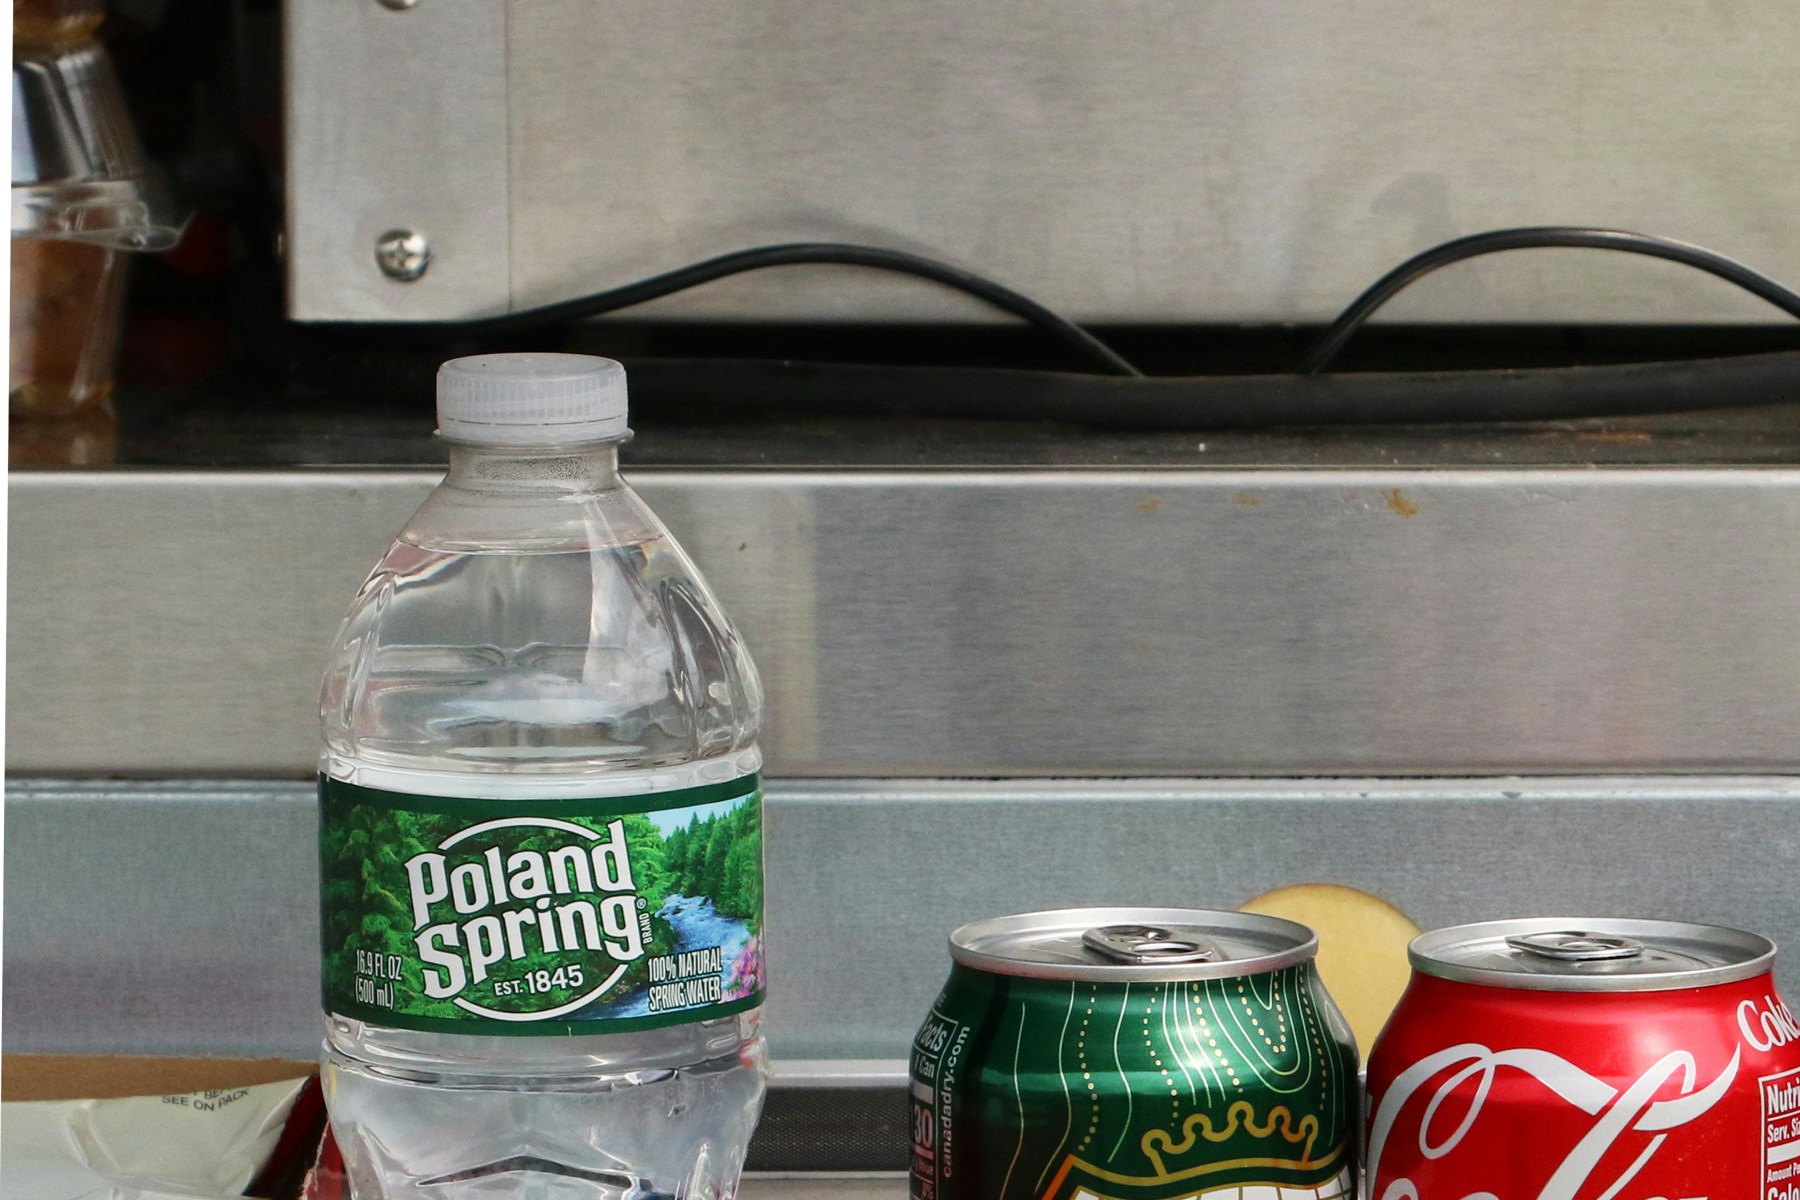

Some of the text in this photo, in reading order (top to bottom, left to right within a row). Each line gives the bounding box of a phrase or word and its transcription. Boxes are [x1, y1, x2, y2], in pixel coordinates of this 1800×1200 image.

[403, 817, 636, 932] Poland
[638, 912, 653, 945] BRAND
[413, 895, 645, 999] Spring
[648, 947, 722, 982] 100% NATURAL
[356, 949, 402, 981] 16.9 FL OZ
[494, 964, 584, 996] EST. 1845
[355, 974, 394, 1010] (500 mL)
[649, 976, 721, 1011] SPRING WATER
[161, 1095, 189, 1107] SEE
[194, 1099, 214, 1111] ON
[218, 1089, 249, 1108] PACK
[941, 1026, 970, 1178] canadadry.com
[1767, 1123, 1790, 1143] Serv.
